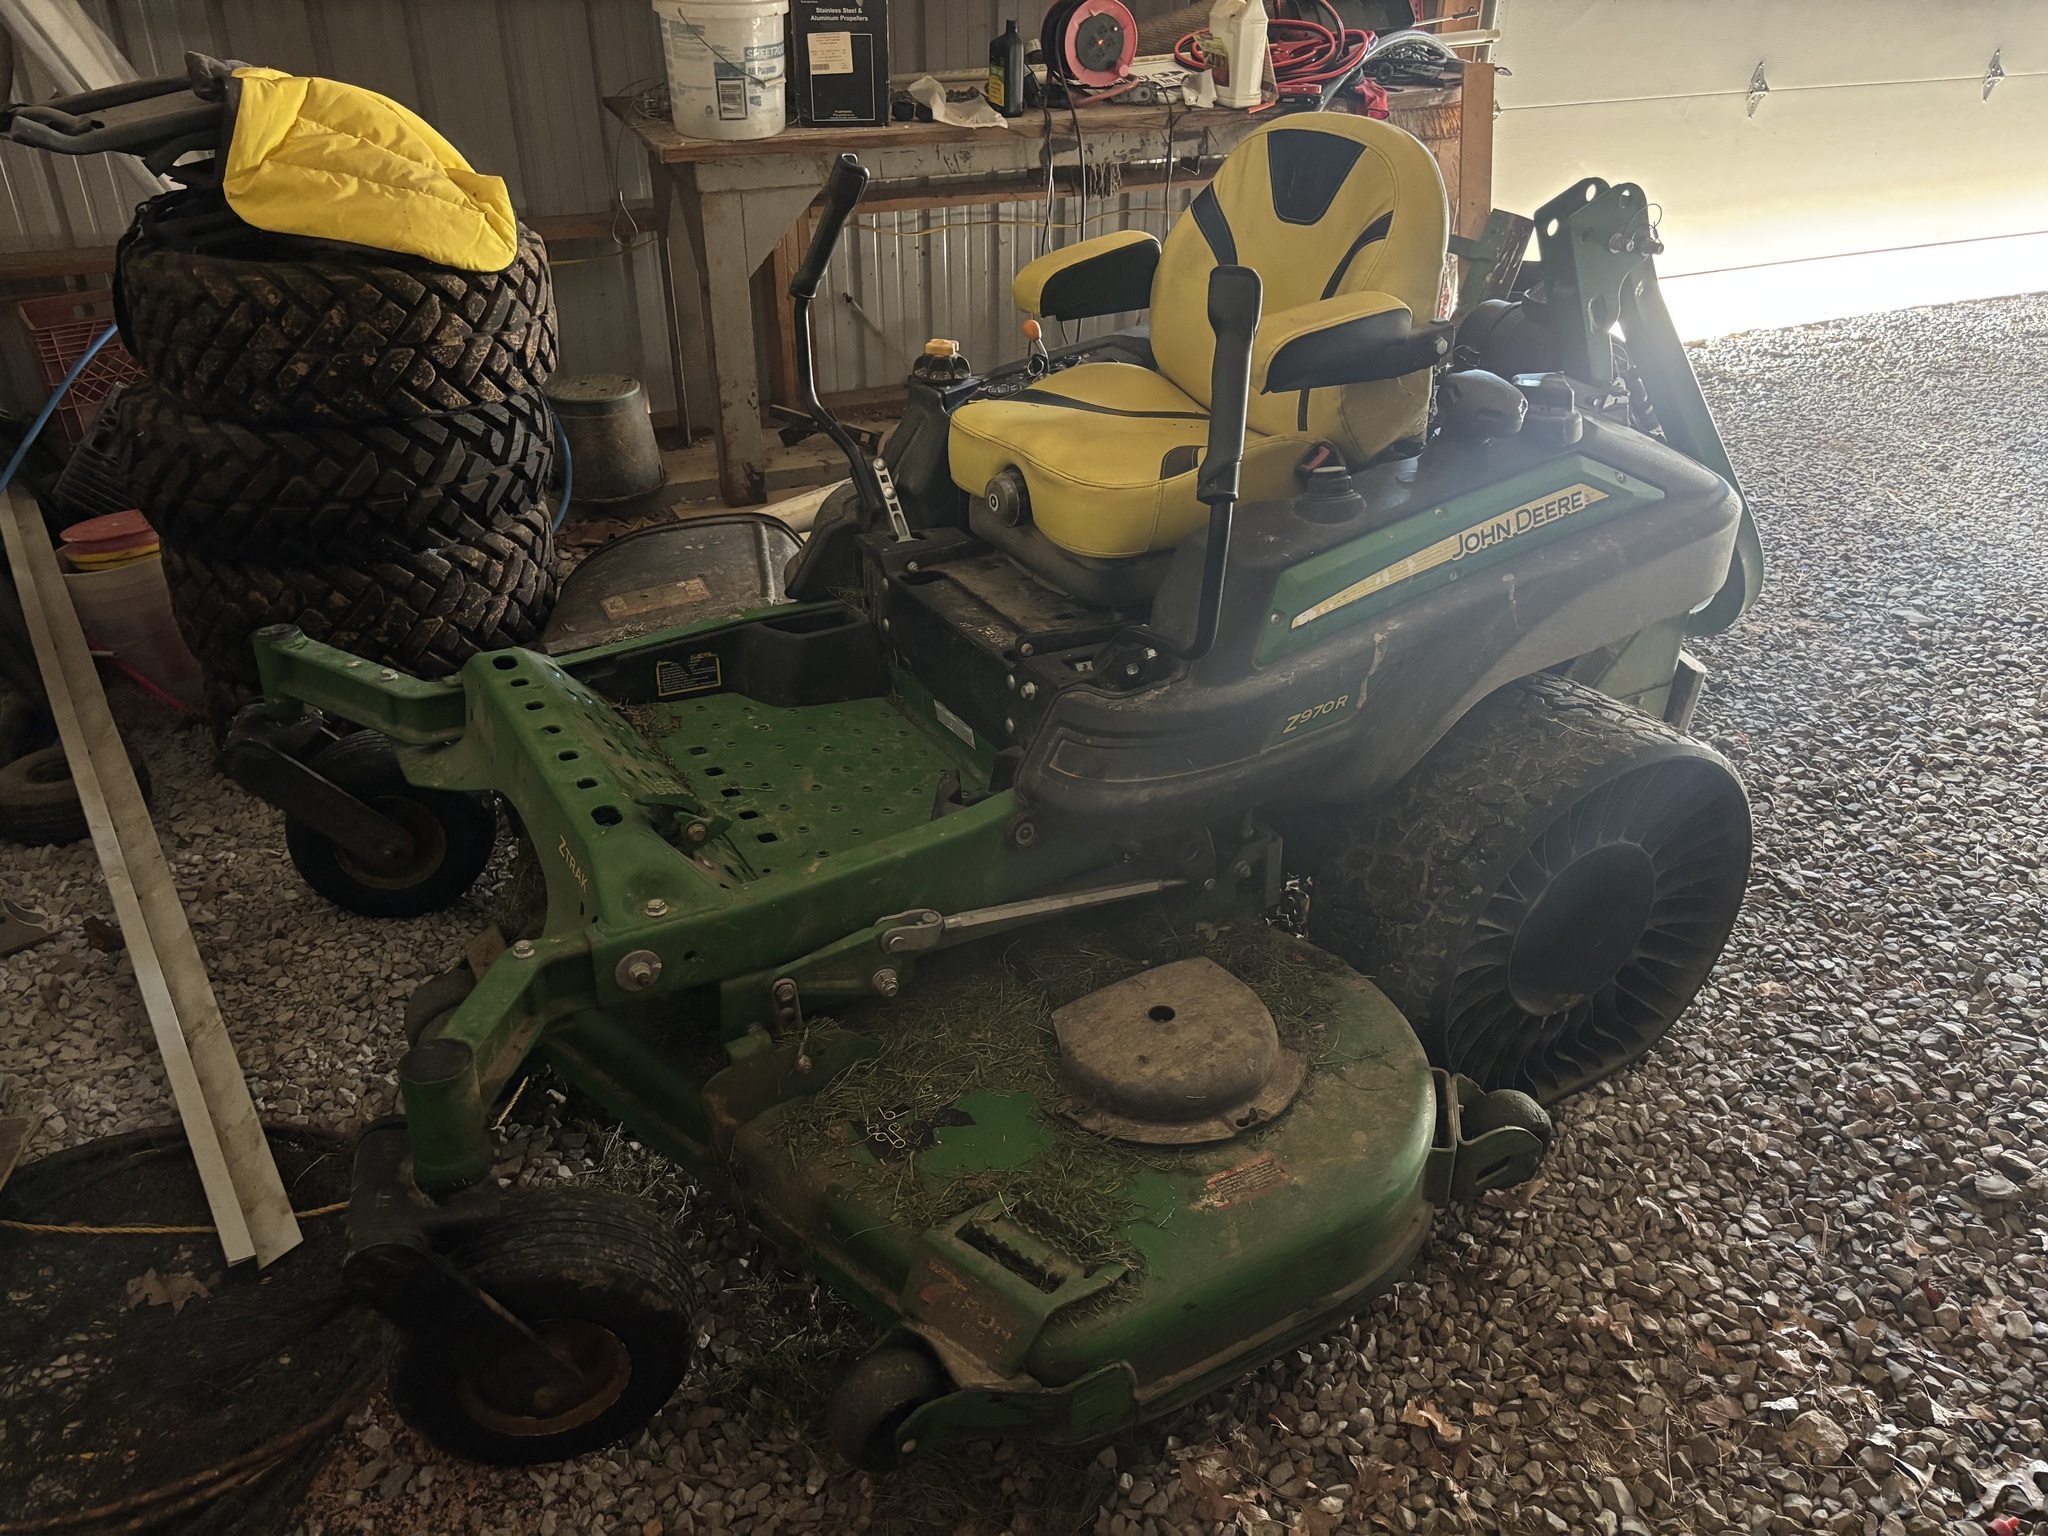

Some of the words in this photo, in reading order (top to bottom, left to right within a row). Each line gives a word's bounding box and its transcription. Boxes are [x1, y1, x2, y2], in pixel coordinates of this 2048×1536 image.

[1452, 518, 1511, 559] JOHN
[1515, 490, 1585, 533] DEERE
[1282, 694, 1349, 734] Z970R
[558, 834, 588, 893] ZTRAK
